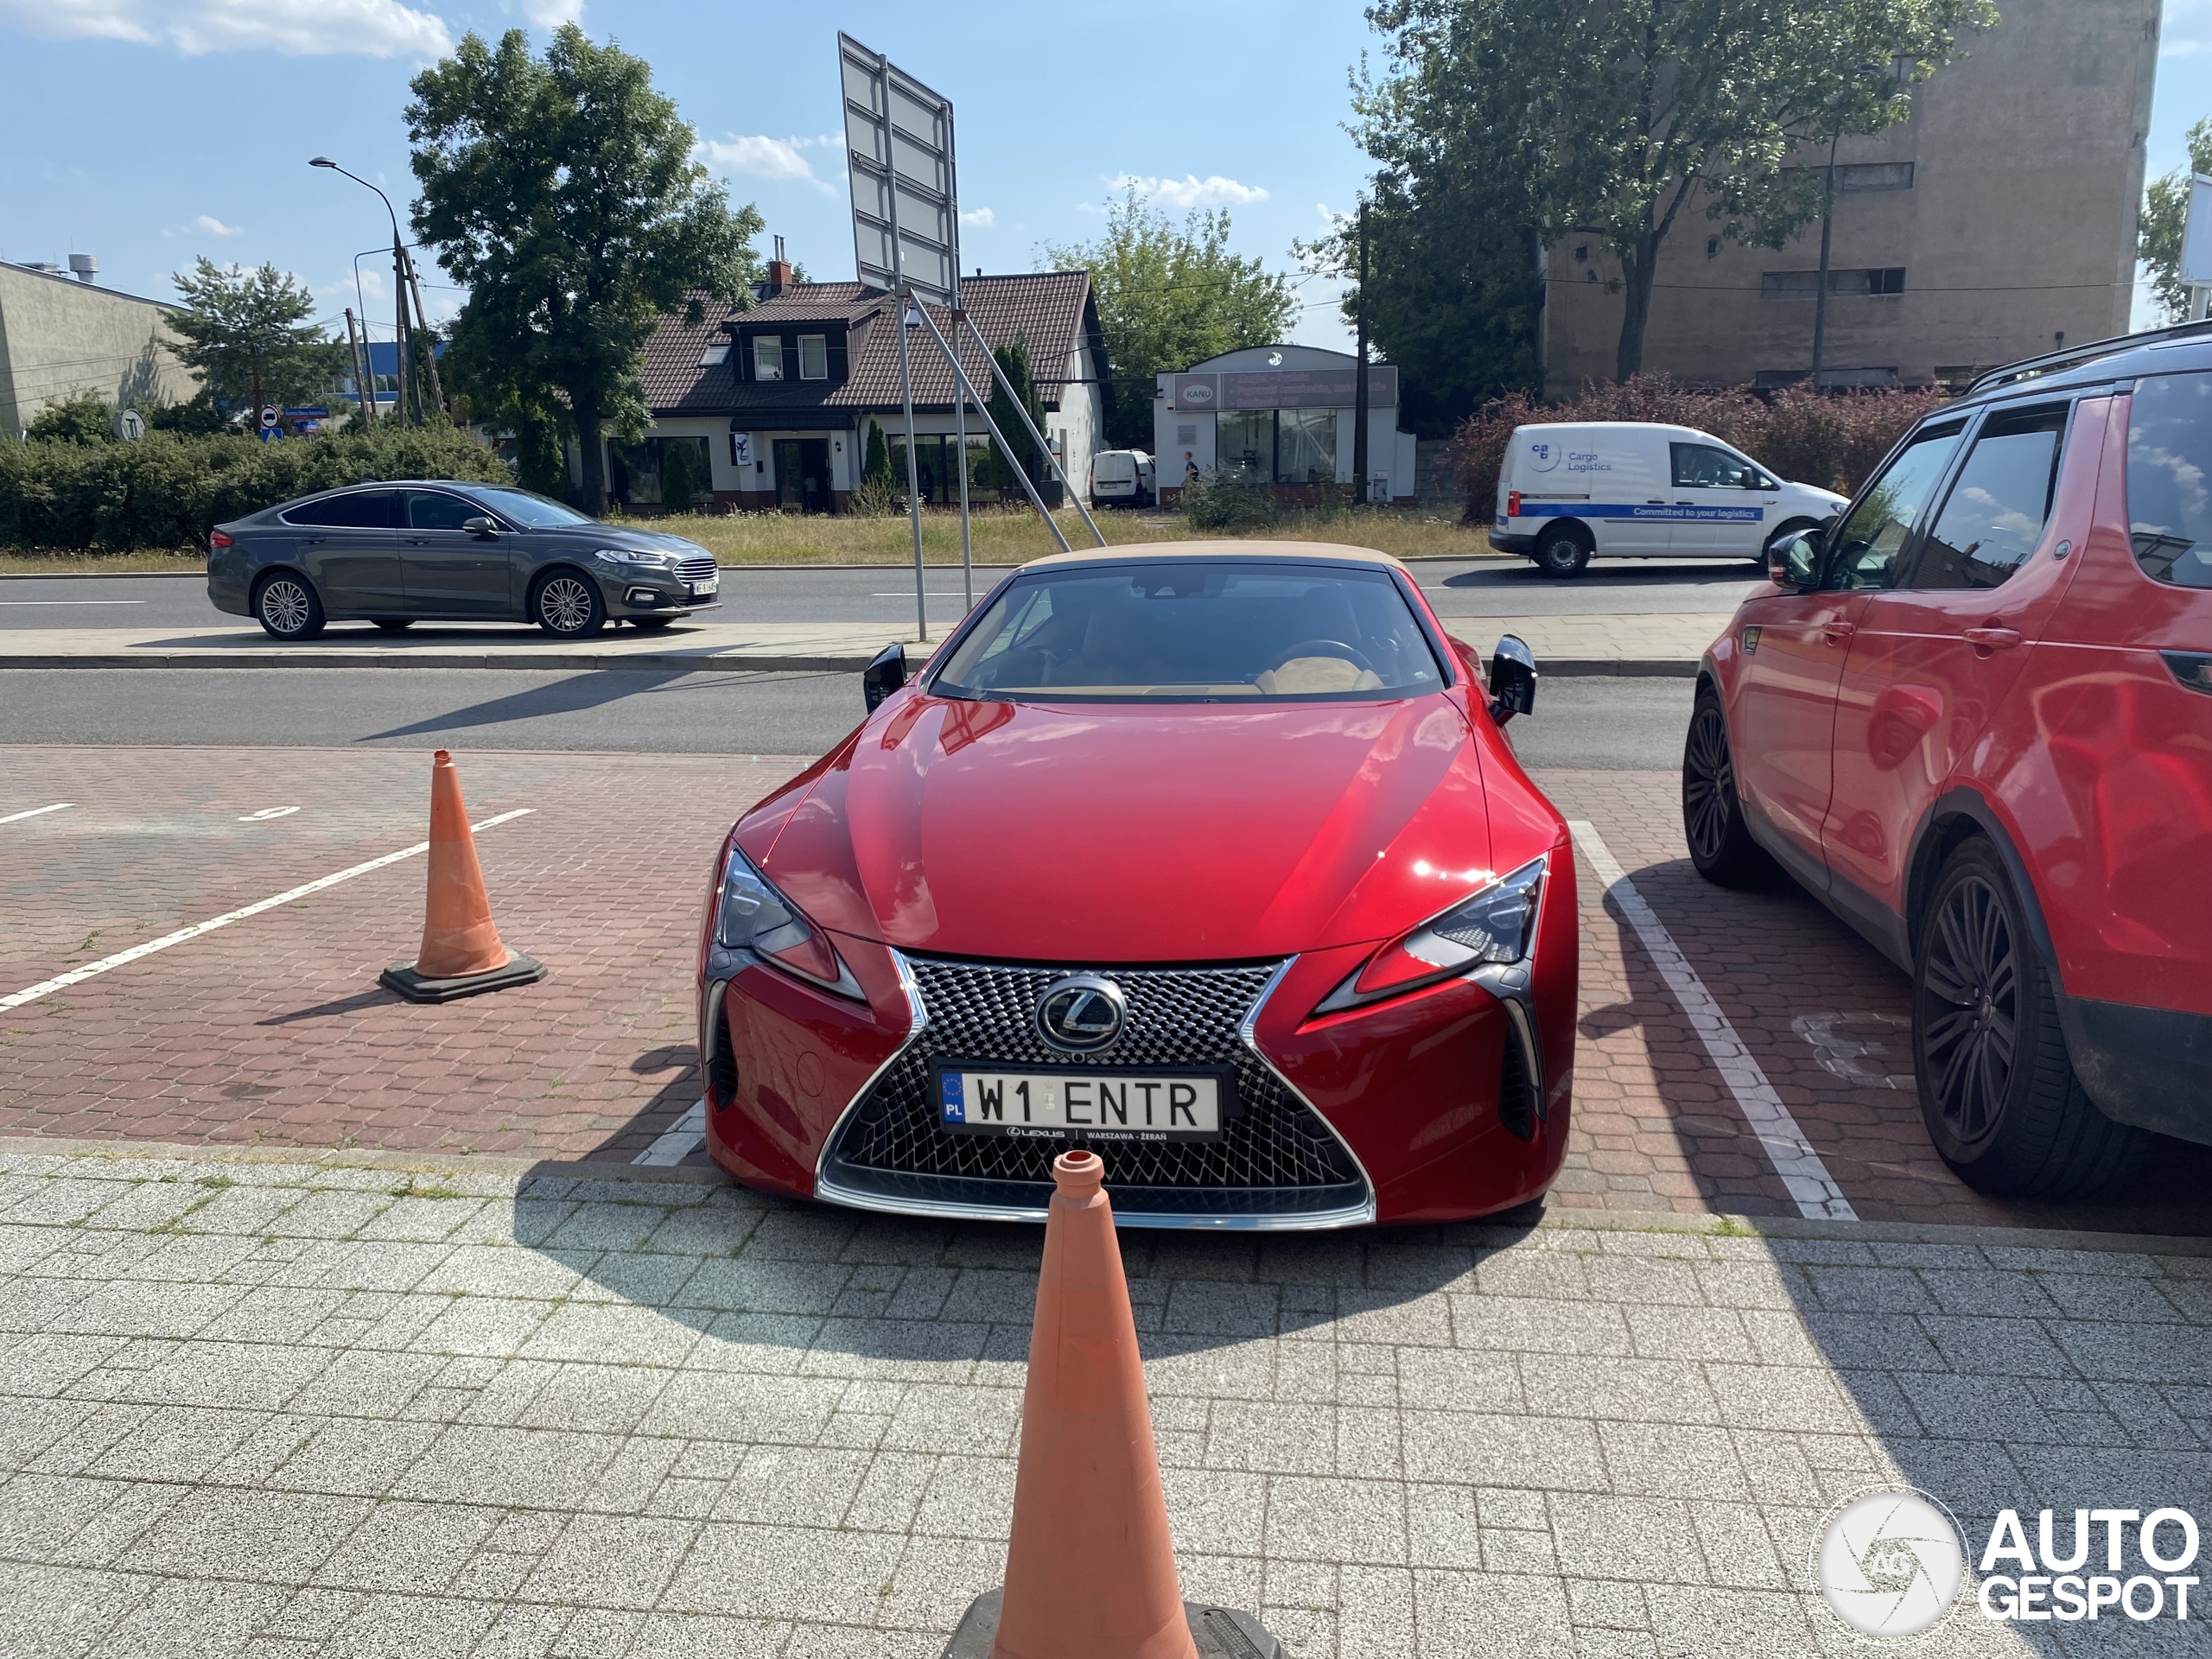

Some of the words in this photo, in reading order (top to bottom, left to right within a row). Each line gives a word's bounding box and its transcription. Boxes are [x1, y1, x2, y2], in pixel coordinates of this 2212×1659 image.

[1569, 453, 1598, 462] Cargo
[1568, 463, 1611, 473] Logistics
[1634, 507, 1684, 517] Committed
[1686, 508, 1695, 517] to
[1697, 510, 1716, 518] your
[1718, 509, 1755, 519] logistics
[977, 1078, 1032, 1122] W1
[1065, 1081, 1198, 1127] ENTR
[945, 1103, 963, 1116] PL
[1021, 1128, 1065, 1138] LEXUS
[1086, 1131, 1135, 1141] WARSZAWA
[1140, 1130, 1167, 1141] ŻERAŃ
